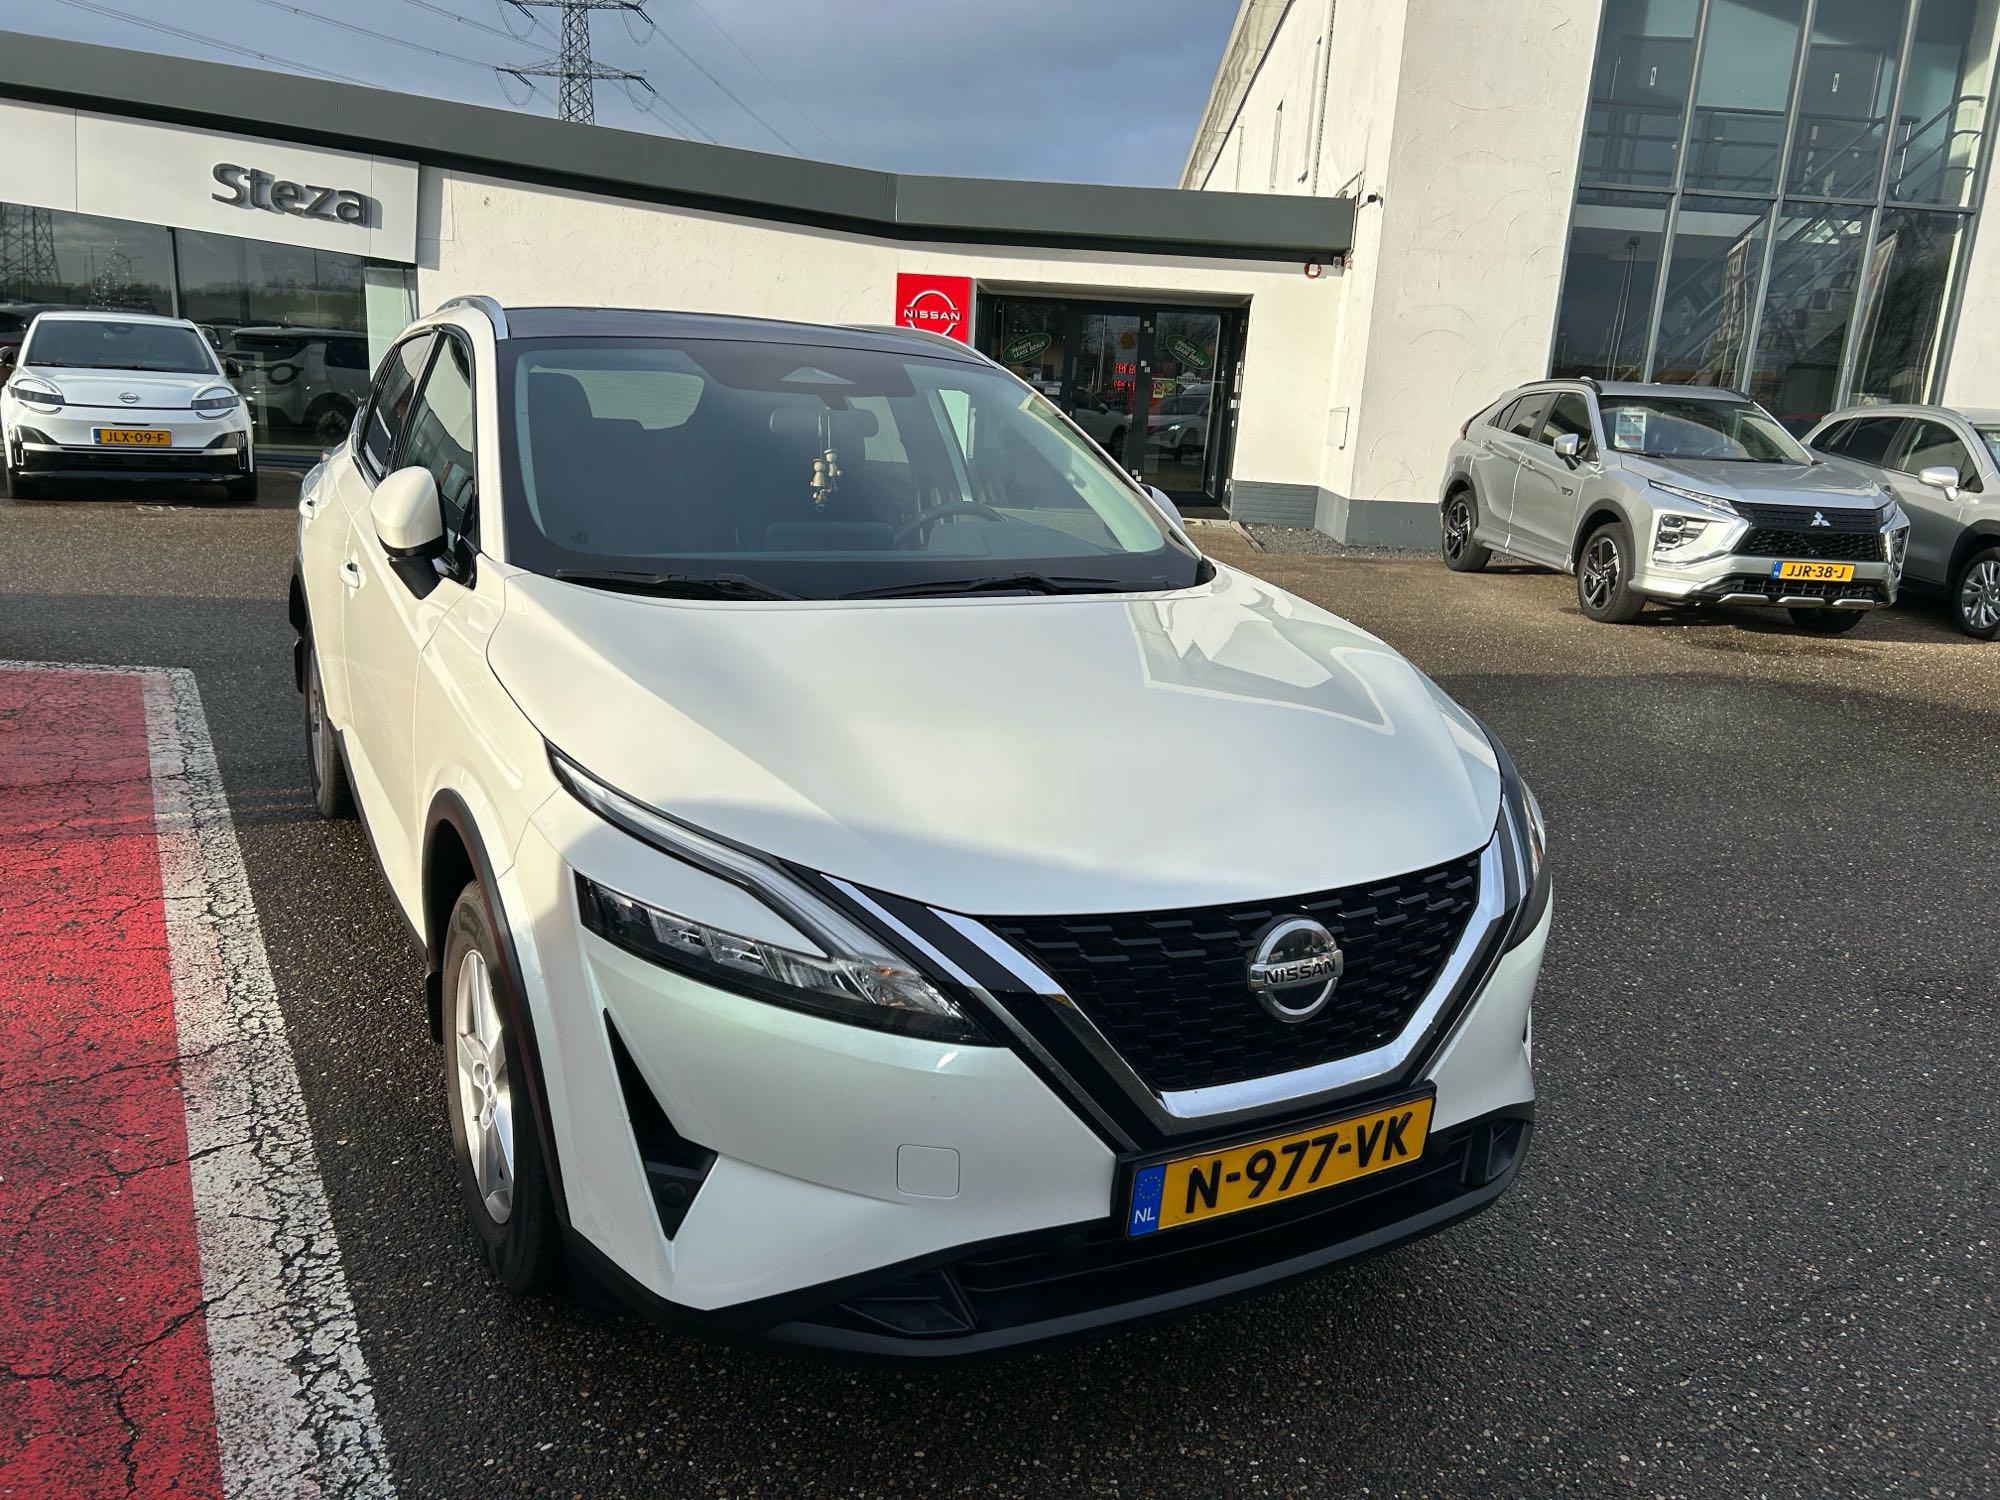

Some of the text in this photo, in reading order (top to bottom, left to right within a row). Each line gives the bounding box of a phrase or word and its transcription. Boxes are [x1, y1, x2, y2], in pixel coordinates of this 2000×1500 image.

[212, 163, 368, 225] Steza
[903, 309, 961, 321] NISSAN
[1012, 341, 1031, 353] PRIVATE
[1029, 340, 1045, 351] DEALS
[1189, 353, 1205, 366] DEALS
[1177, 377, 1201, 385] NISSAN
[107, 431, 164, 443] JLX-09-F
[1787, 565, 1846, 578] JJR-38-J
[1264, 959, 1336, 984] NISSAN
[1134, 1112, 1413, 1224] NL N-977-VK
